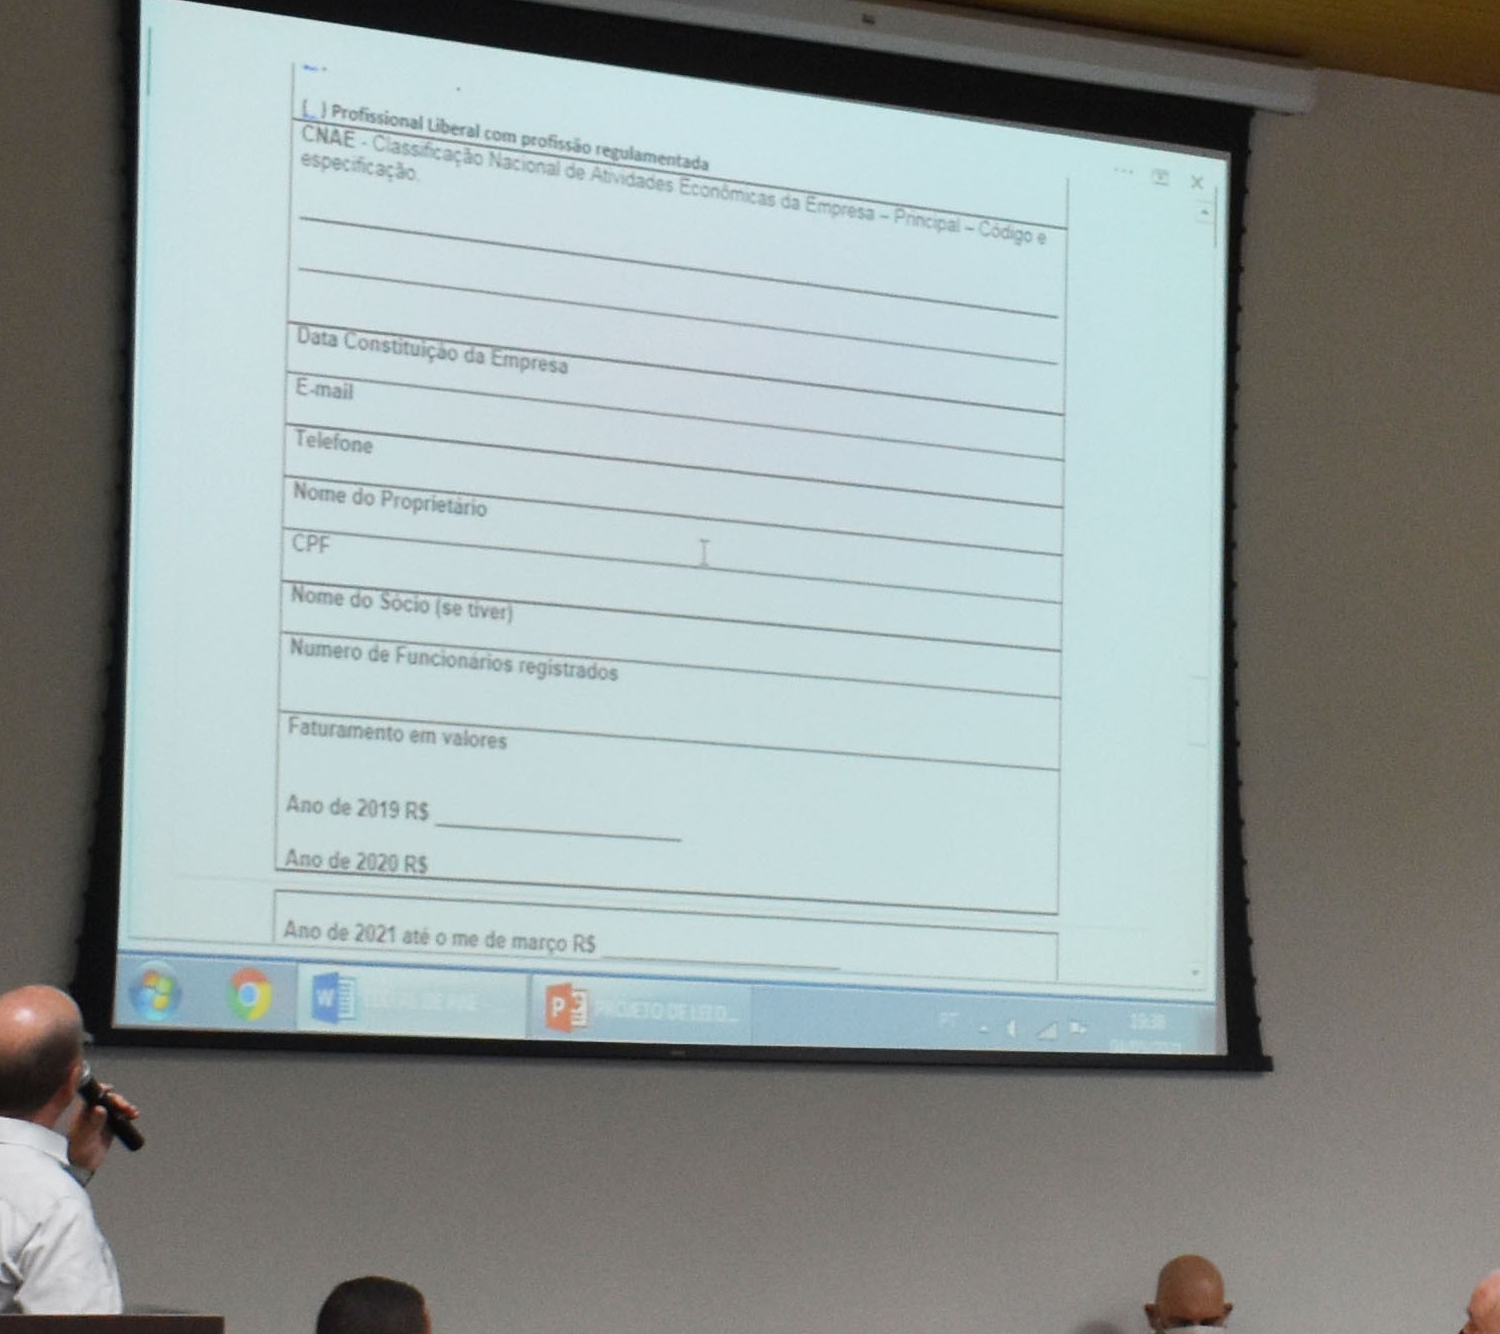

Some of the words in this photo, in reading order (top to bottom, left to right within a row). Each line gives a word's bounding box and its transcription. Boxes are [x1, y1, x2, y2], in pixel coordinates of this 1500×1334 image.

[332, 104, 424, 131] Profissional
[428, 117, 480, 140] Liberal
[485, 128, 517, 145] com
[521, 132, 592, 157] profissão
[596, 142, 710, 172] regulamentada
[301, 151, 420, 182] especificação.
[301, 125, 355, 148] CNAE
[373, 135, 483, 168] Classificação
[489, 153, 561, 178] Nacional
[566, 162, 586, 180] de
[590, 165, 673, 194] Atividades
[680, 176, 776, 208] Econômicas
[781, 193, 800, 211] da
[805, 196, 875, 221] Empresa
[894, 207, 960, 234] Principal
[980, 218, 1033, 246] Código
[1039, 231, 1047, 245] e
[297, 326, 338, 348] Data
[344, 332, 458, 364] Constituição
[464, 345, 485, 365] da
[492, 348, 569, 376] Empresa
[296, 378, 354, 401] E-mail
[296, 429, 373, 455] Telefone
[293, 482, 346, 505] Nome
[352, 486, 376, 507] do
[381, 490, 487, 518] Proprietário
[292, 534, 330, 554] CPF
[291, 586, 344, 607] Nome
[350, 591, 373, 610] do
[380, 592, 430, 615] Sócio
[435, 597, 462, 619] (se
[468, 602, 514, 624] tiver)
[290, 637, 363, 662] Numero
[368, 642, 390, 663] de
[395, 645, 513, 674] Funcionários
[518, 656, 619, 682] registrados
[288, 716, 403, 744] Faturamento
[410, 728, 437, 746] em
[443, 728, 508, 750] valores
[286, 794, 324, 816] Ano
[329, 797, 351, 817] de
[357, 799, 400, 820] 2019
[405, 801, 429, 821] R$
[285, 848, 323, 869] Ano
[329, 851, 351, 871] de
[356, 853, 400, 873] 2020
[404, 855, 428, 875] R$
[283, 920, 321, 941] Ano
[327, 923, 349, 943] de
[355, 925, 396, 945] 2021
[402, 926, 430, 946] até
[436, 932, 447, 947] o
[452, 932, 479, 948] me
[485, 930, 506, 950] de
[512, 936, 567, 956] março
[573, 934, 597, 955] R$
